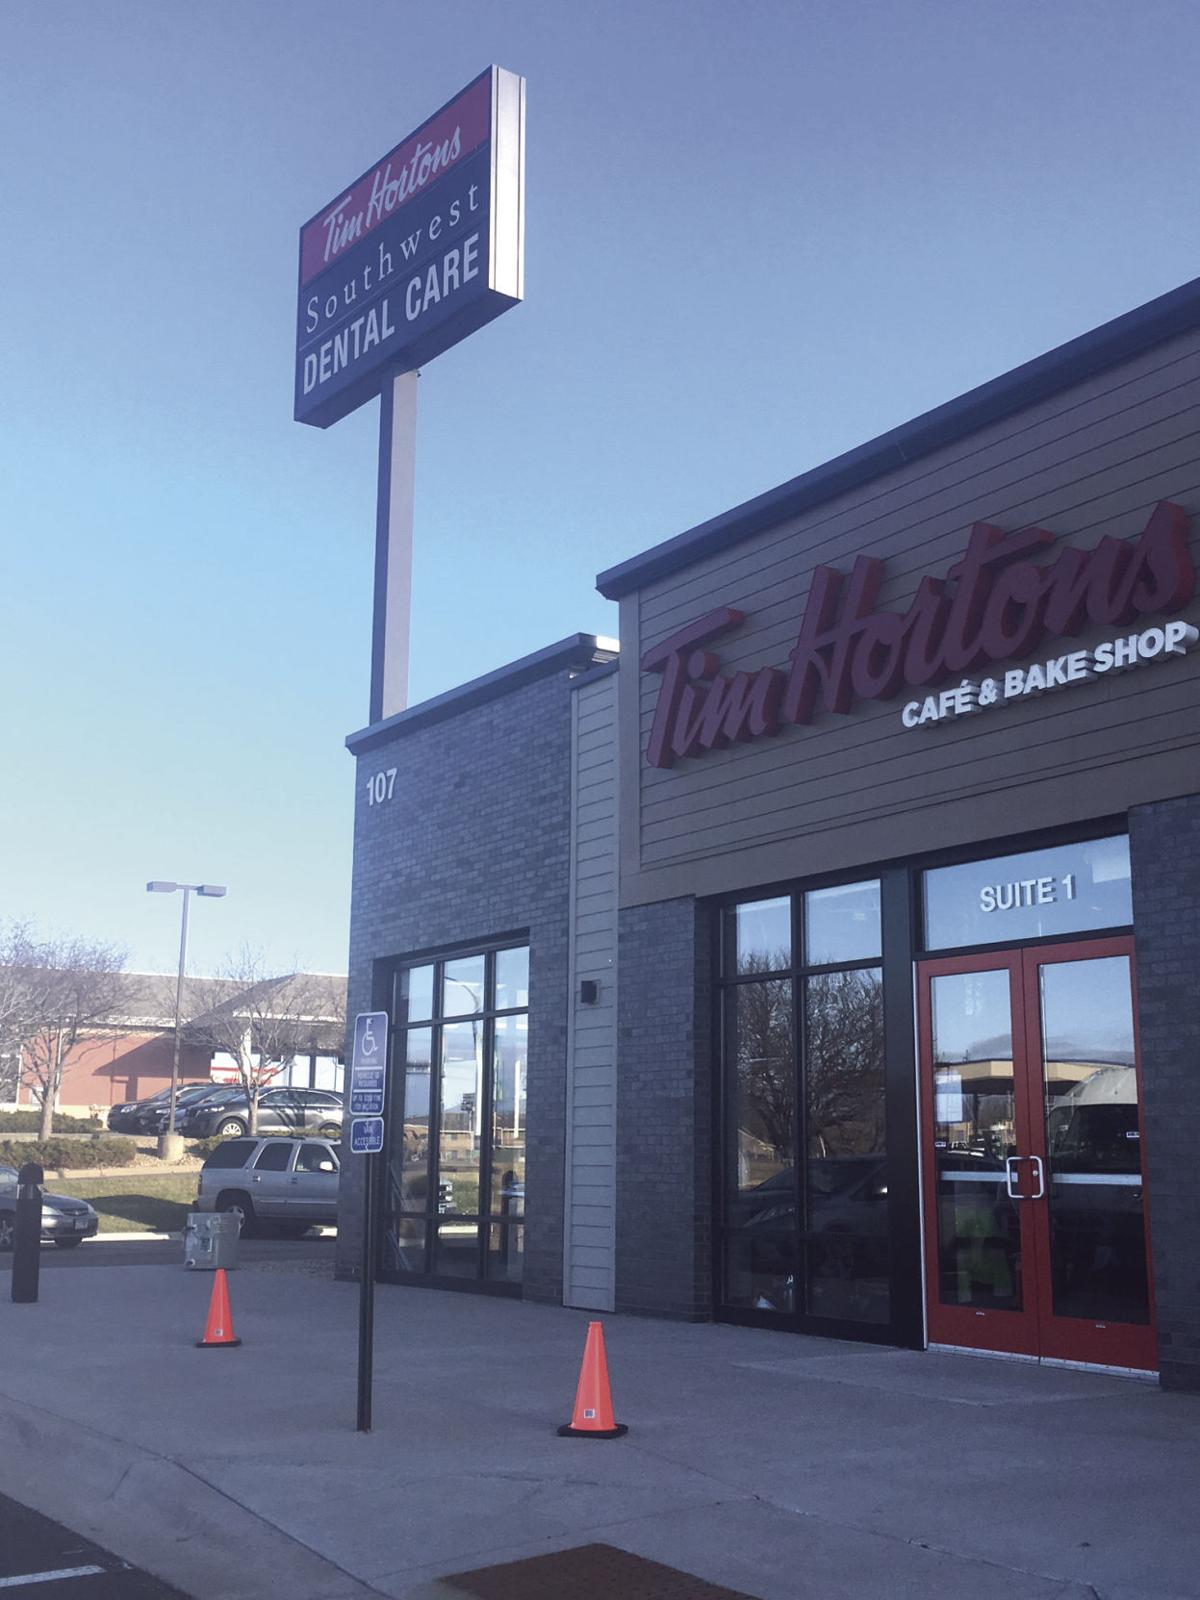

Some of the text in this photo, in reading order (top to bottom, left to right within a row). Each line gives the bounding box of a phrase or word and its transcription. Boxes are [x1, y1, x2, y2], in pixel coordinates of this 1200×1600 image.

[306, 184, 479, 334] Southwest
[323, 126, 461, 262] Tim Hortons
[303, 232, 480, 396] DENTAL CARE
[641, 500, 1194, 769] Tim Hortons
[901, 620, 1192, 728] CAFÉ & BAKE SHOP
[366, 767, 398, 807] 107
[979, 873, 1075, 913] SUITE 1
